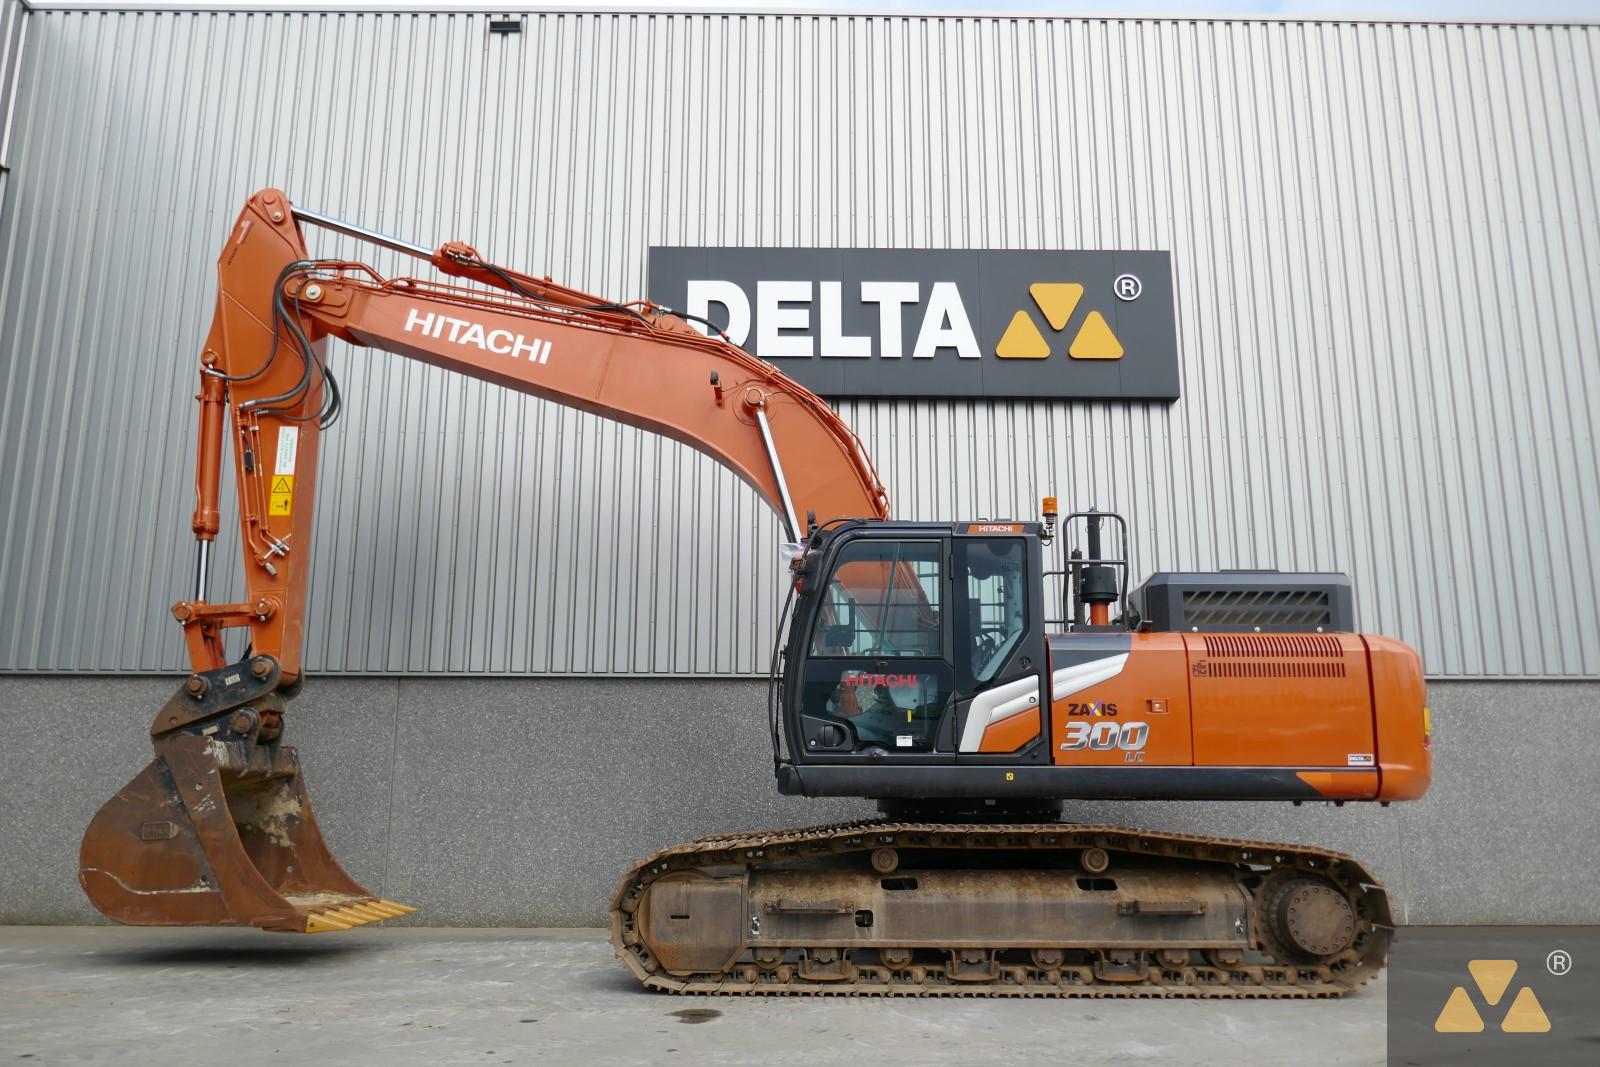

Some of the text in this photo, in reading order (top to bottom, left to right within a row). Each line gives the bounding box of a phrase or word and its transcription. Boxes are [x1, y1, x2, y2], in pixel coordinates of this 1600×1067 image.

[687, 280, 981, 358] DELTA
[404, 308, 552, 364] HITACHI
[846, 674, 918, 688] HITACHI
[1068, 699, 1118, 717] ZAXIS
[1060, 721, 1150, 751] 300
